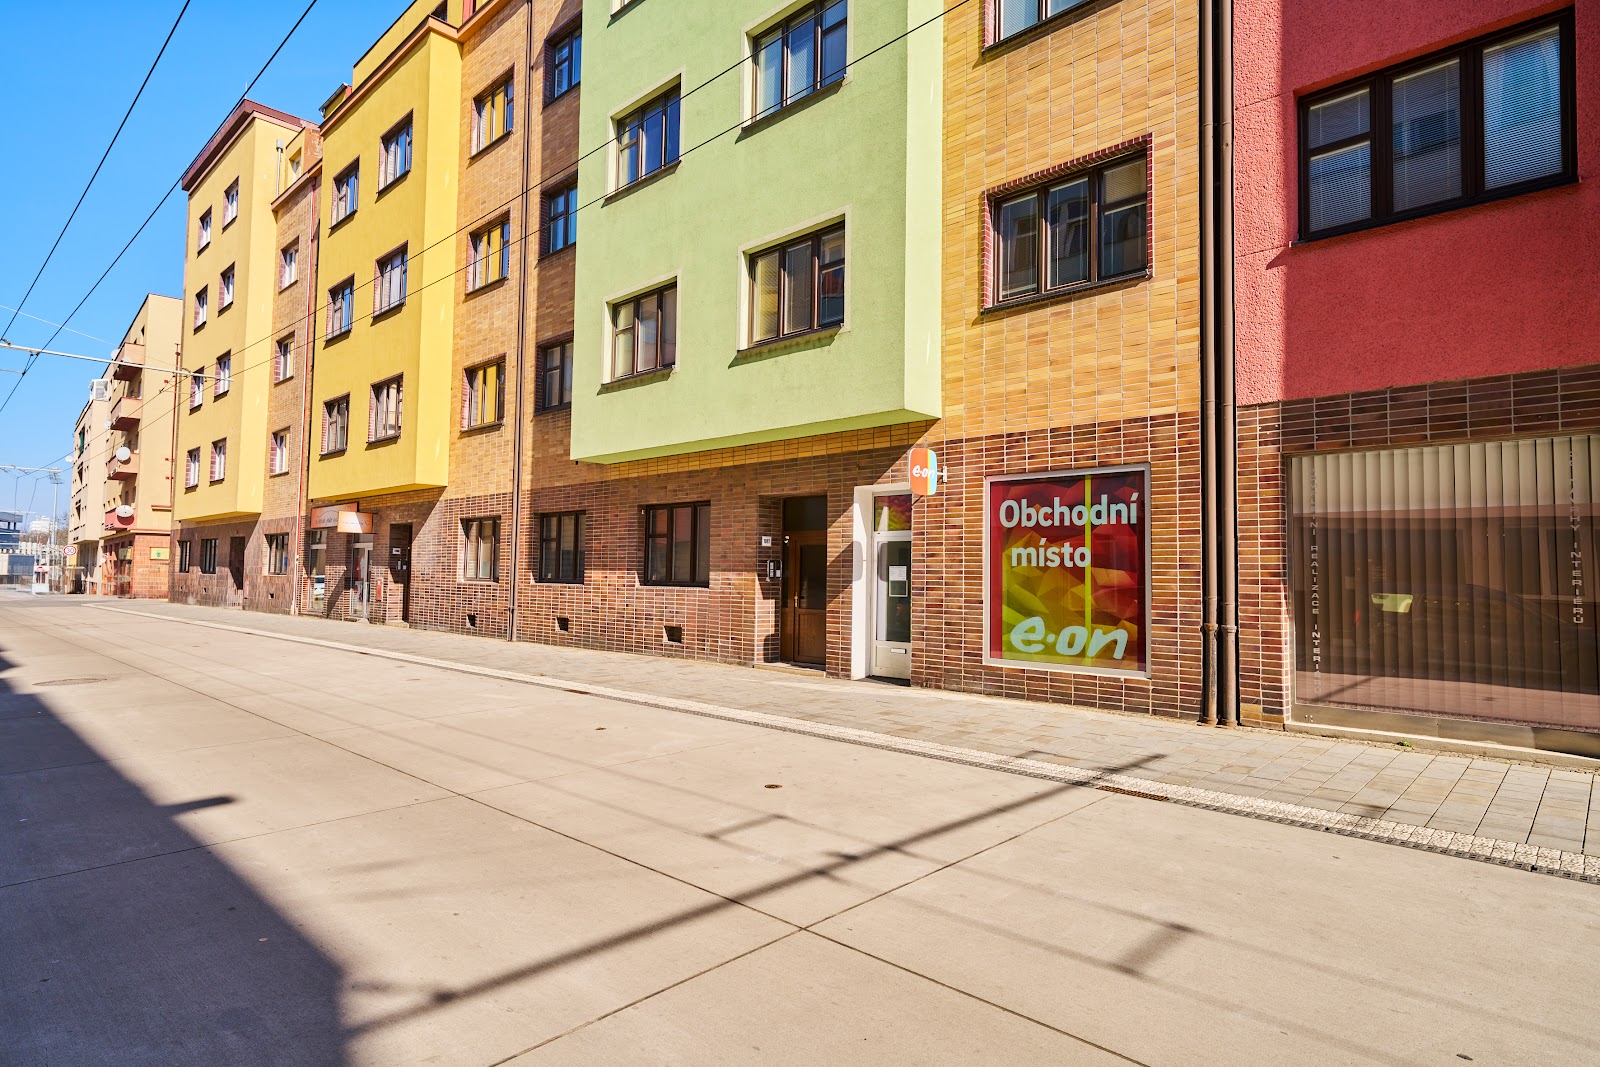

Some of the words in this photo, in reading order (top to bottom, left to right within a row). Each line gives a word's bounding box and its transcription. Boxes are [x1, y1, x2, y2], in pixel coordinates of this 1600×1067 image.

[999, 493, 1139, 528] Obchodní
[1011, 538, 1091, 568] místo
[1311, 545, 1320, 614] REALIZACE
